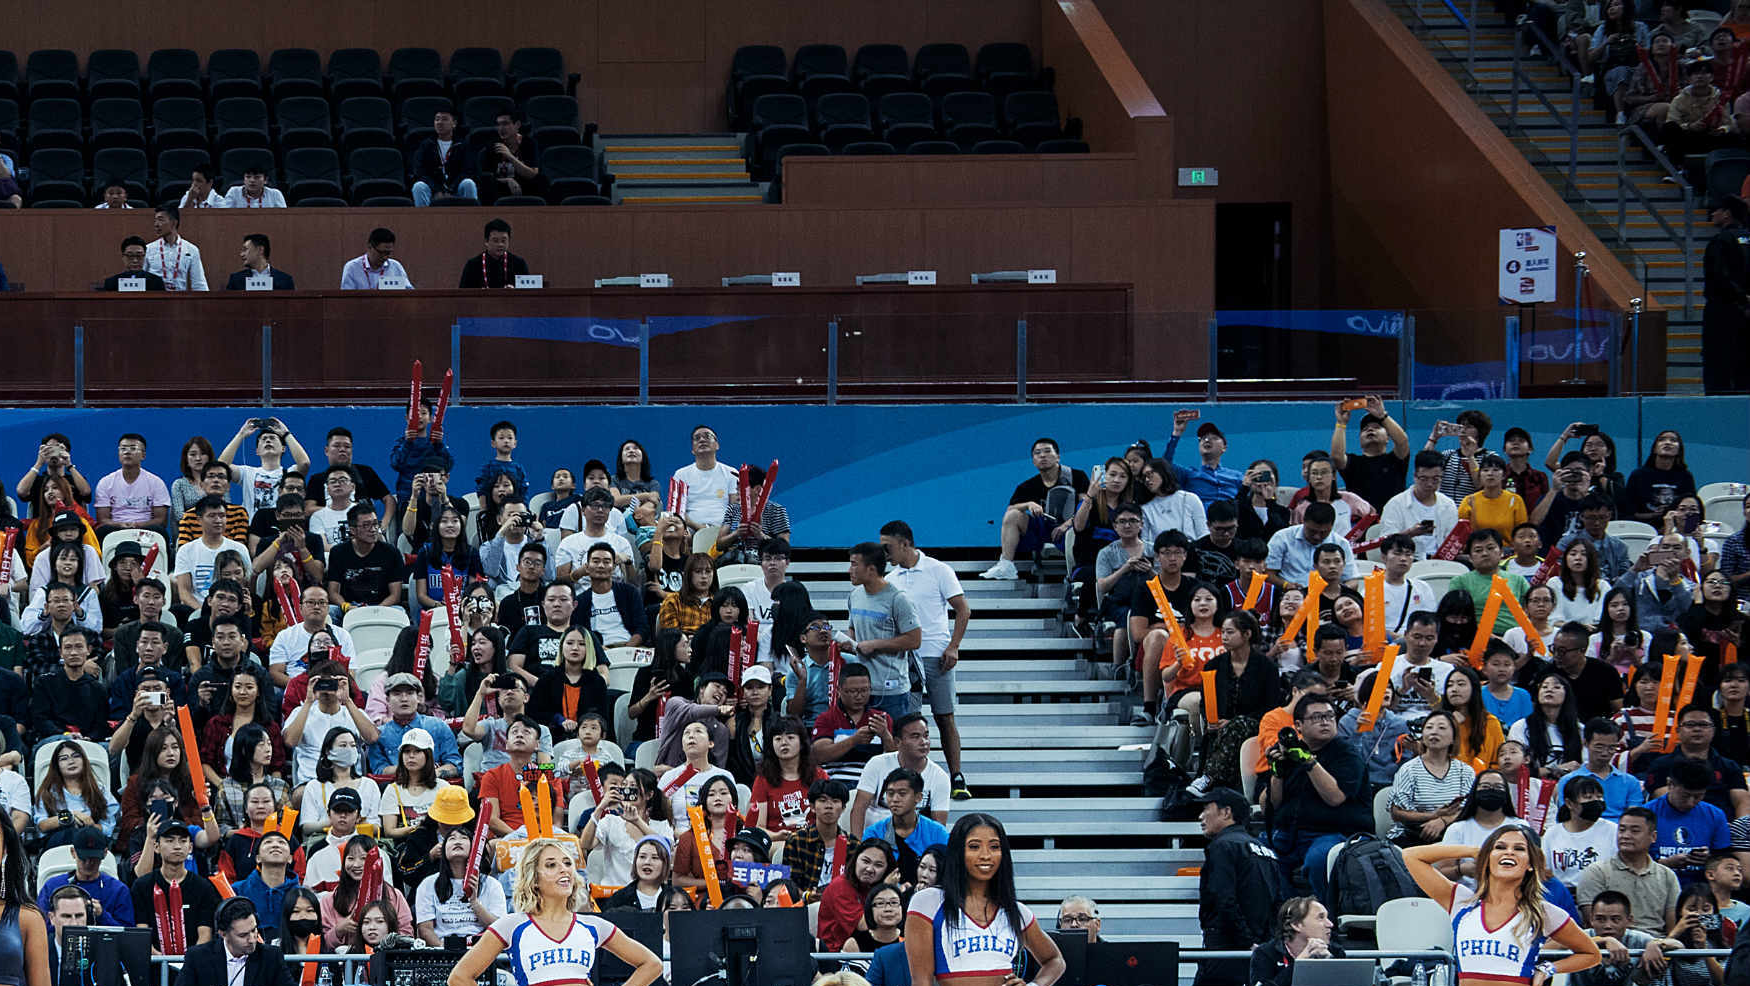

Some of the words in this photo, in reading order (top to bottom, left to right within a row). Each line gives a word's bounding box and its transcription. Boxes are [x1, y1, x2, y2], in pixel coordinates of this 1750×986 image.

[952, 934, 1016, 958] PHILA
[1461, 939, 1520, 963] PHILA
[529, 949, 591, 971] PHILA
